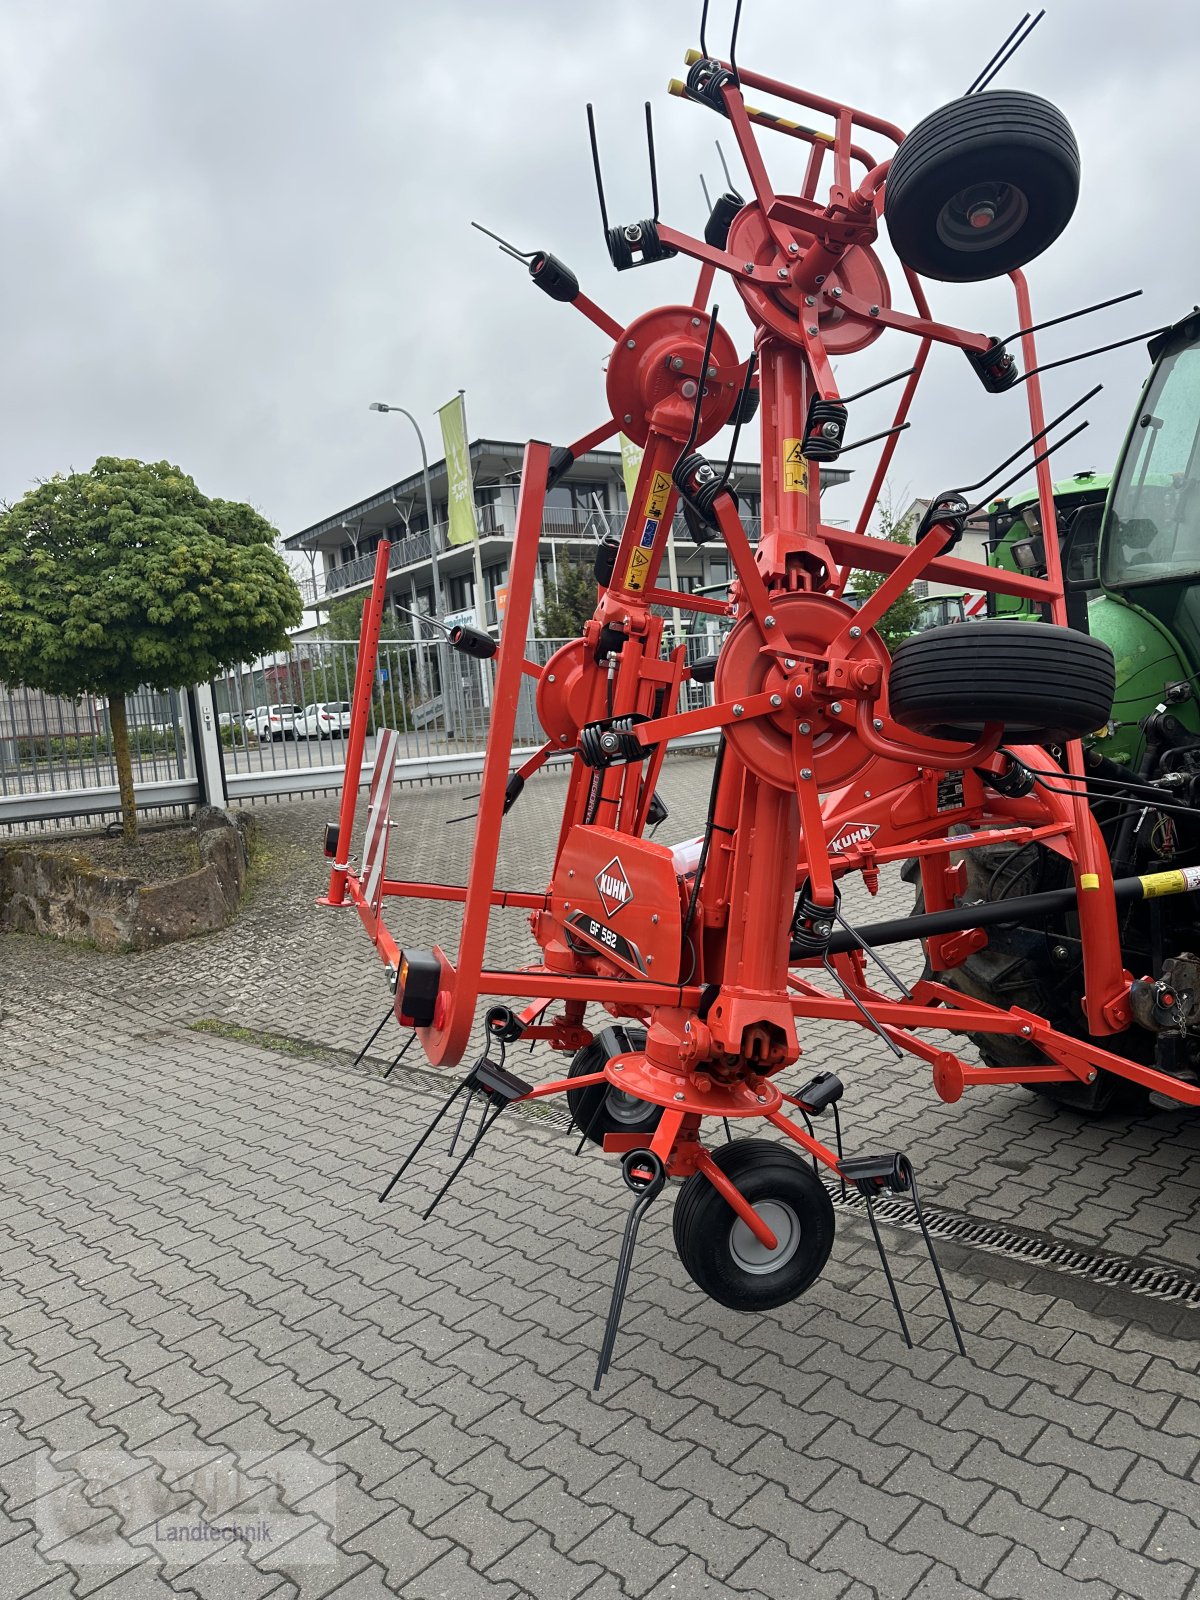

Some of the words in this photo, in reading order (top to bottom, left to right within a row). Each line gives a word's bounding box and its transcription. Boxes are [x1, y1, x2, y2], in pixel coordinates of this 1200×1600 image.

[499, 595, 508, 604] ST
[832, 826, 871, 852] KUHN
[600, 873, 627, 903] KUHN
[589, 920, 600, 936] GF
[601, 928, 617, 949] 582
